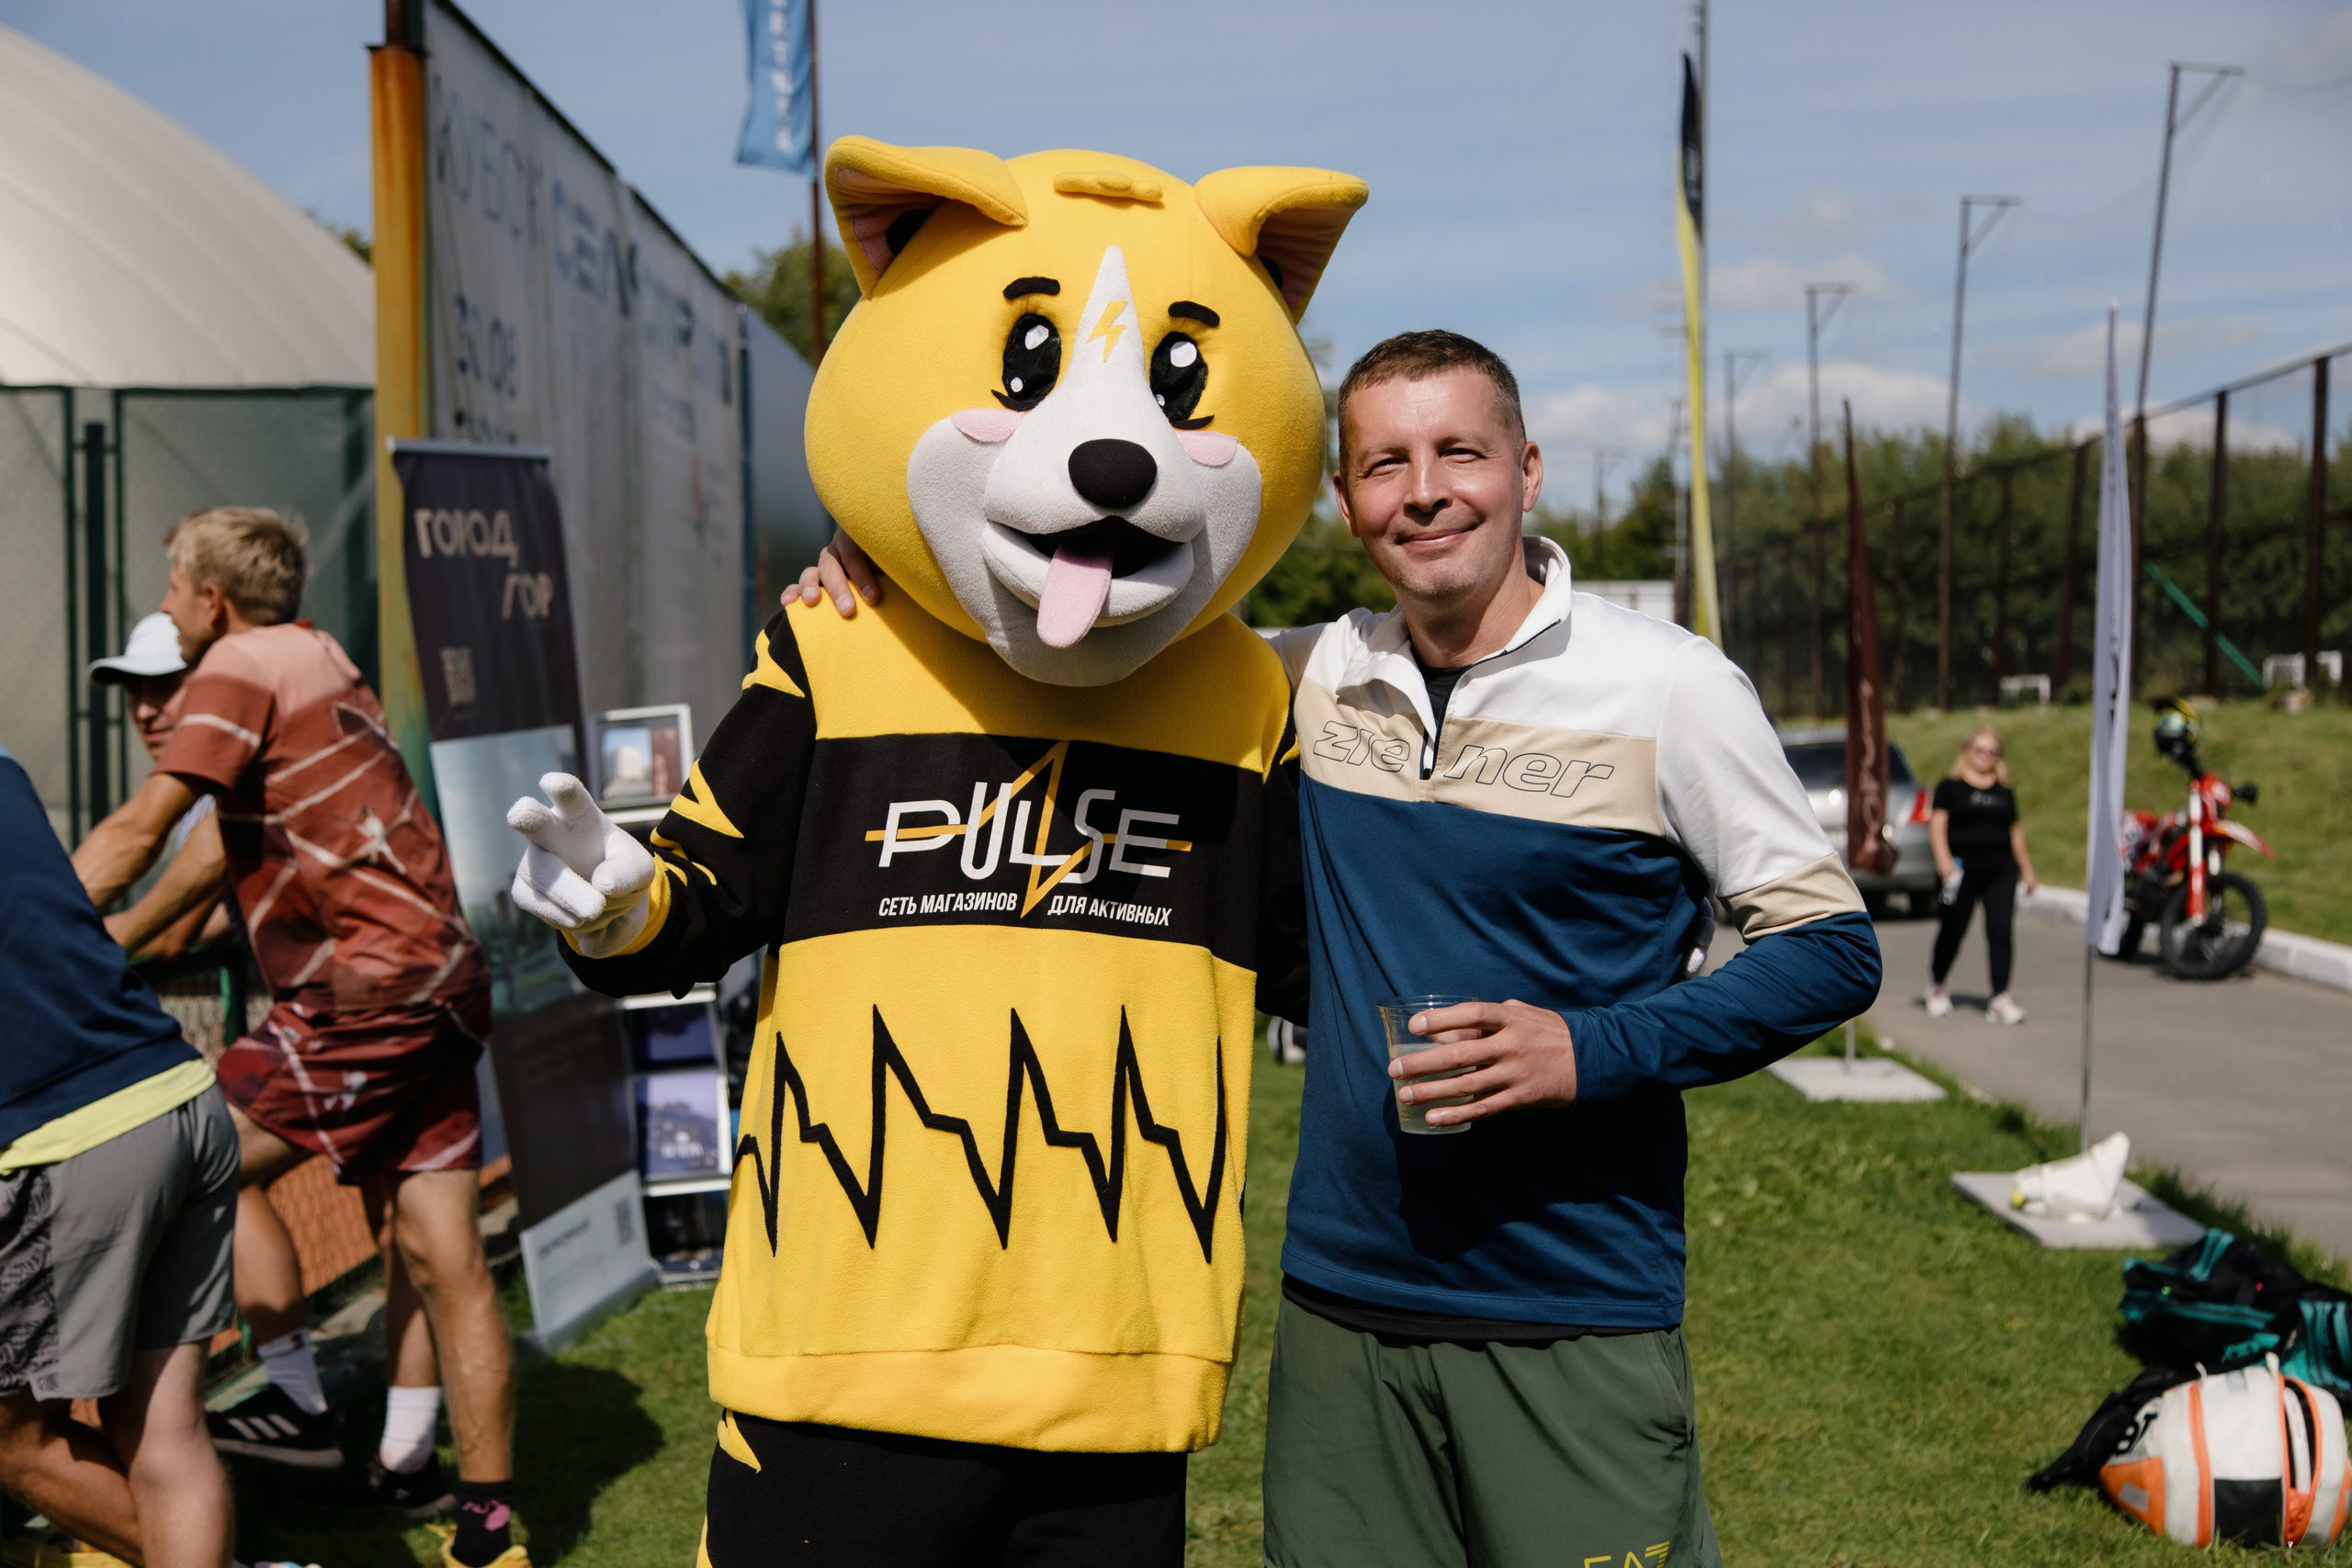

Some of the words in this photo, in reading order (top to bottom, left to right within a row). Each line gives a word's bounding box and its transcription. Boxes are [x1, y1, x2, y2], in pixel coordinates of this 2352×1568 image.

[878, 781, 1181, 885] PULSE
[878, 895, 917, 917] СЕТЬ
[920, 891, 1018, 915] МАГАЗИНОВ
[1046, 895, 1086, 917] ДЛЯ
[1088, 897, 1173, 927] АКТИВНЫХ
